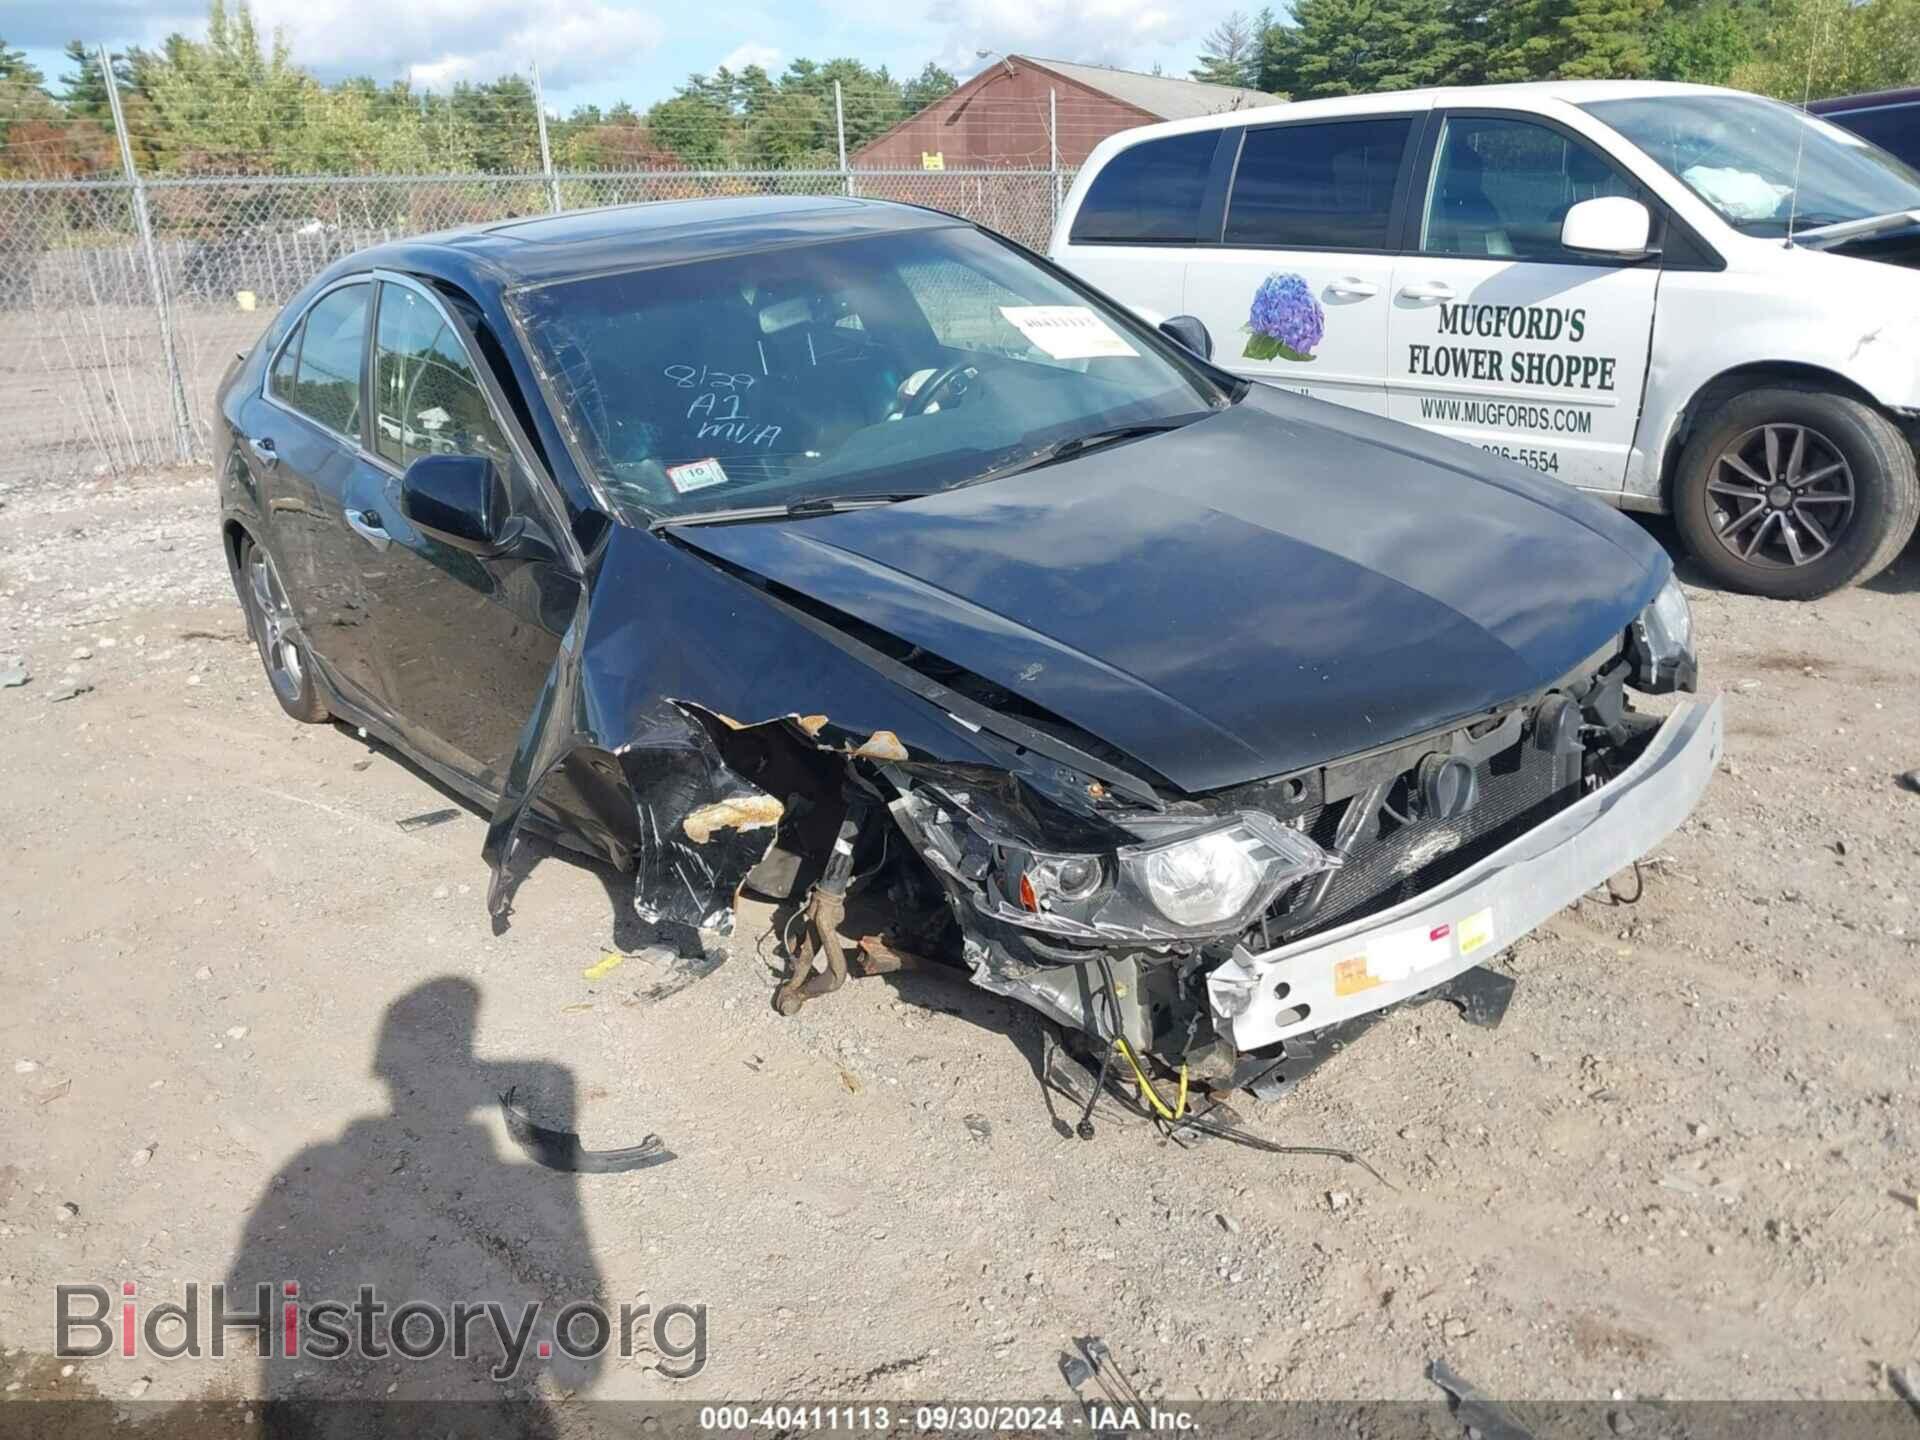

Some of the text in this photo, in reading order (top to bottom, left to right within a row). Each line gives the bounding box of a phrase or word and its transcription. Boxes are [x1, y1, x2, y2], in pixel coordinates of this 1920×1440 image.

[1437, 303, 1586, 342] MUGFORD'S
[1408, 344, 1616, 390] FLOWER SHOPPE
[1420, 398, 1592, 433] WWW.MUGFORDS.COM
